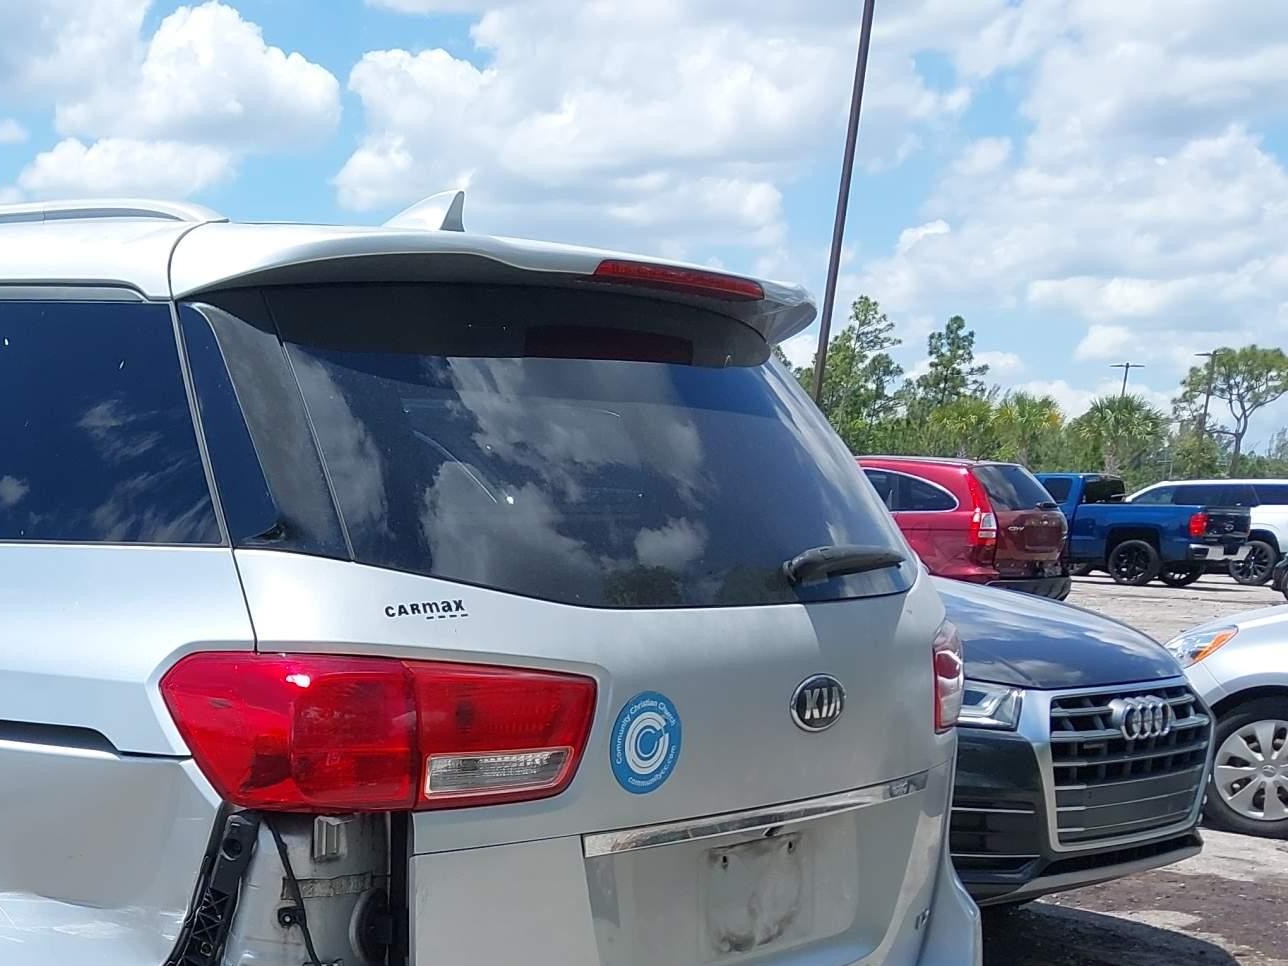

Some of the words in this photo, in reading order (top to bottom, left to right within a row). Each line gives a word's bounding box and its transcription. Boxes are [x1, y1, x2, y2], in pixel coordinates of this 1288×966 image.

[804, 687, 841, 719] KIA
[615, 713, 631, 765] Community
[629, 698, 658, 715] Christian
[658, 702, 676, 727] Church
